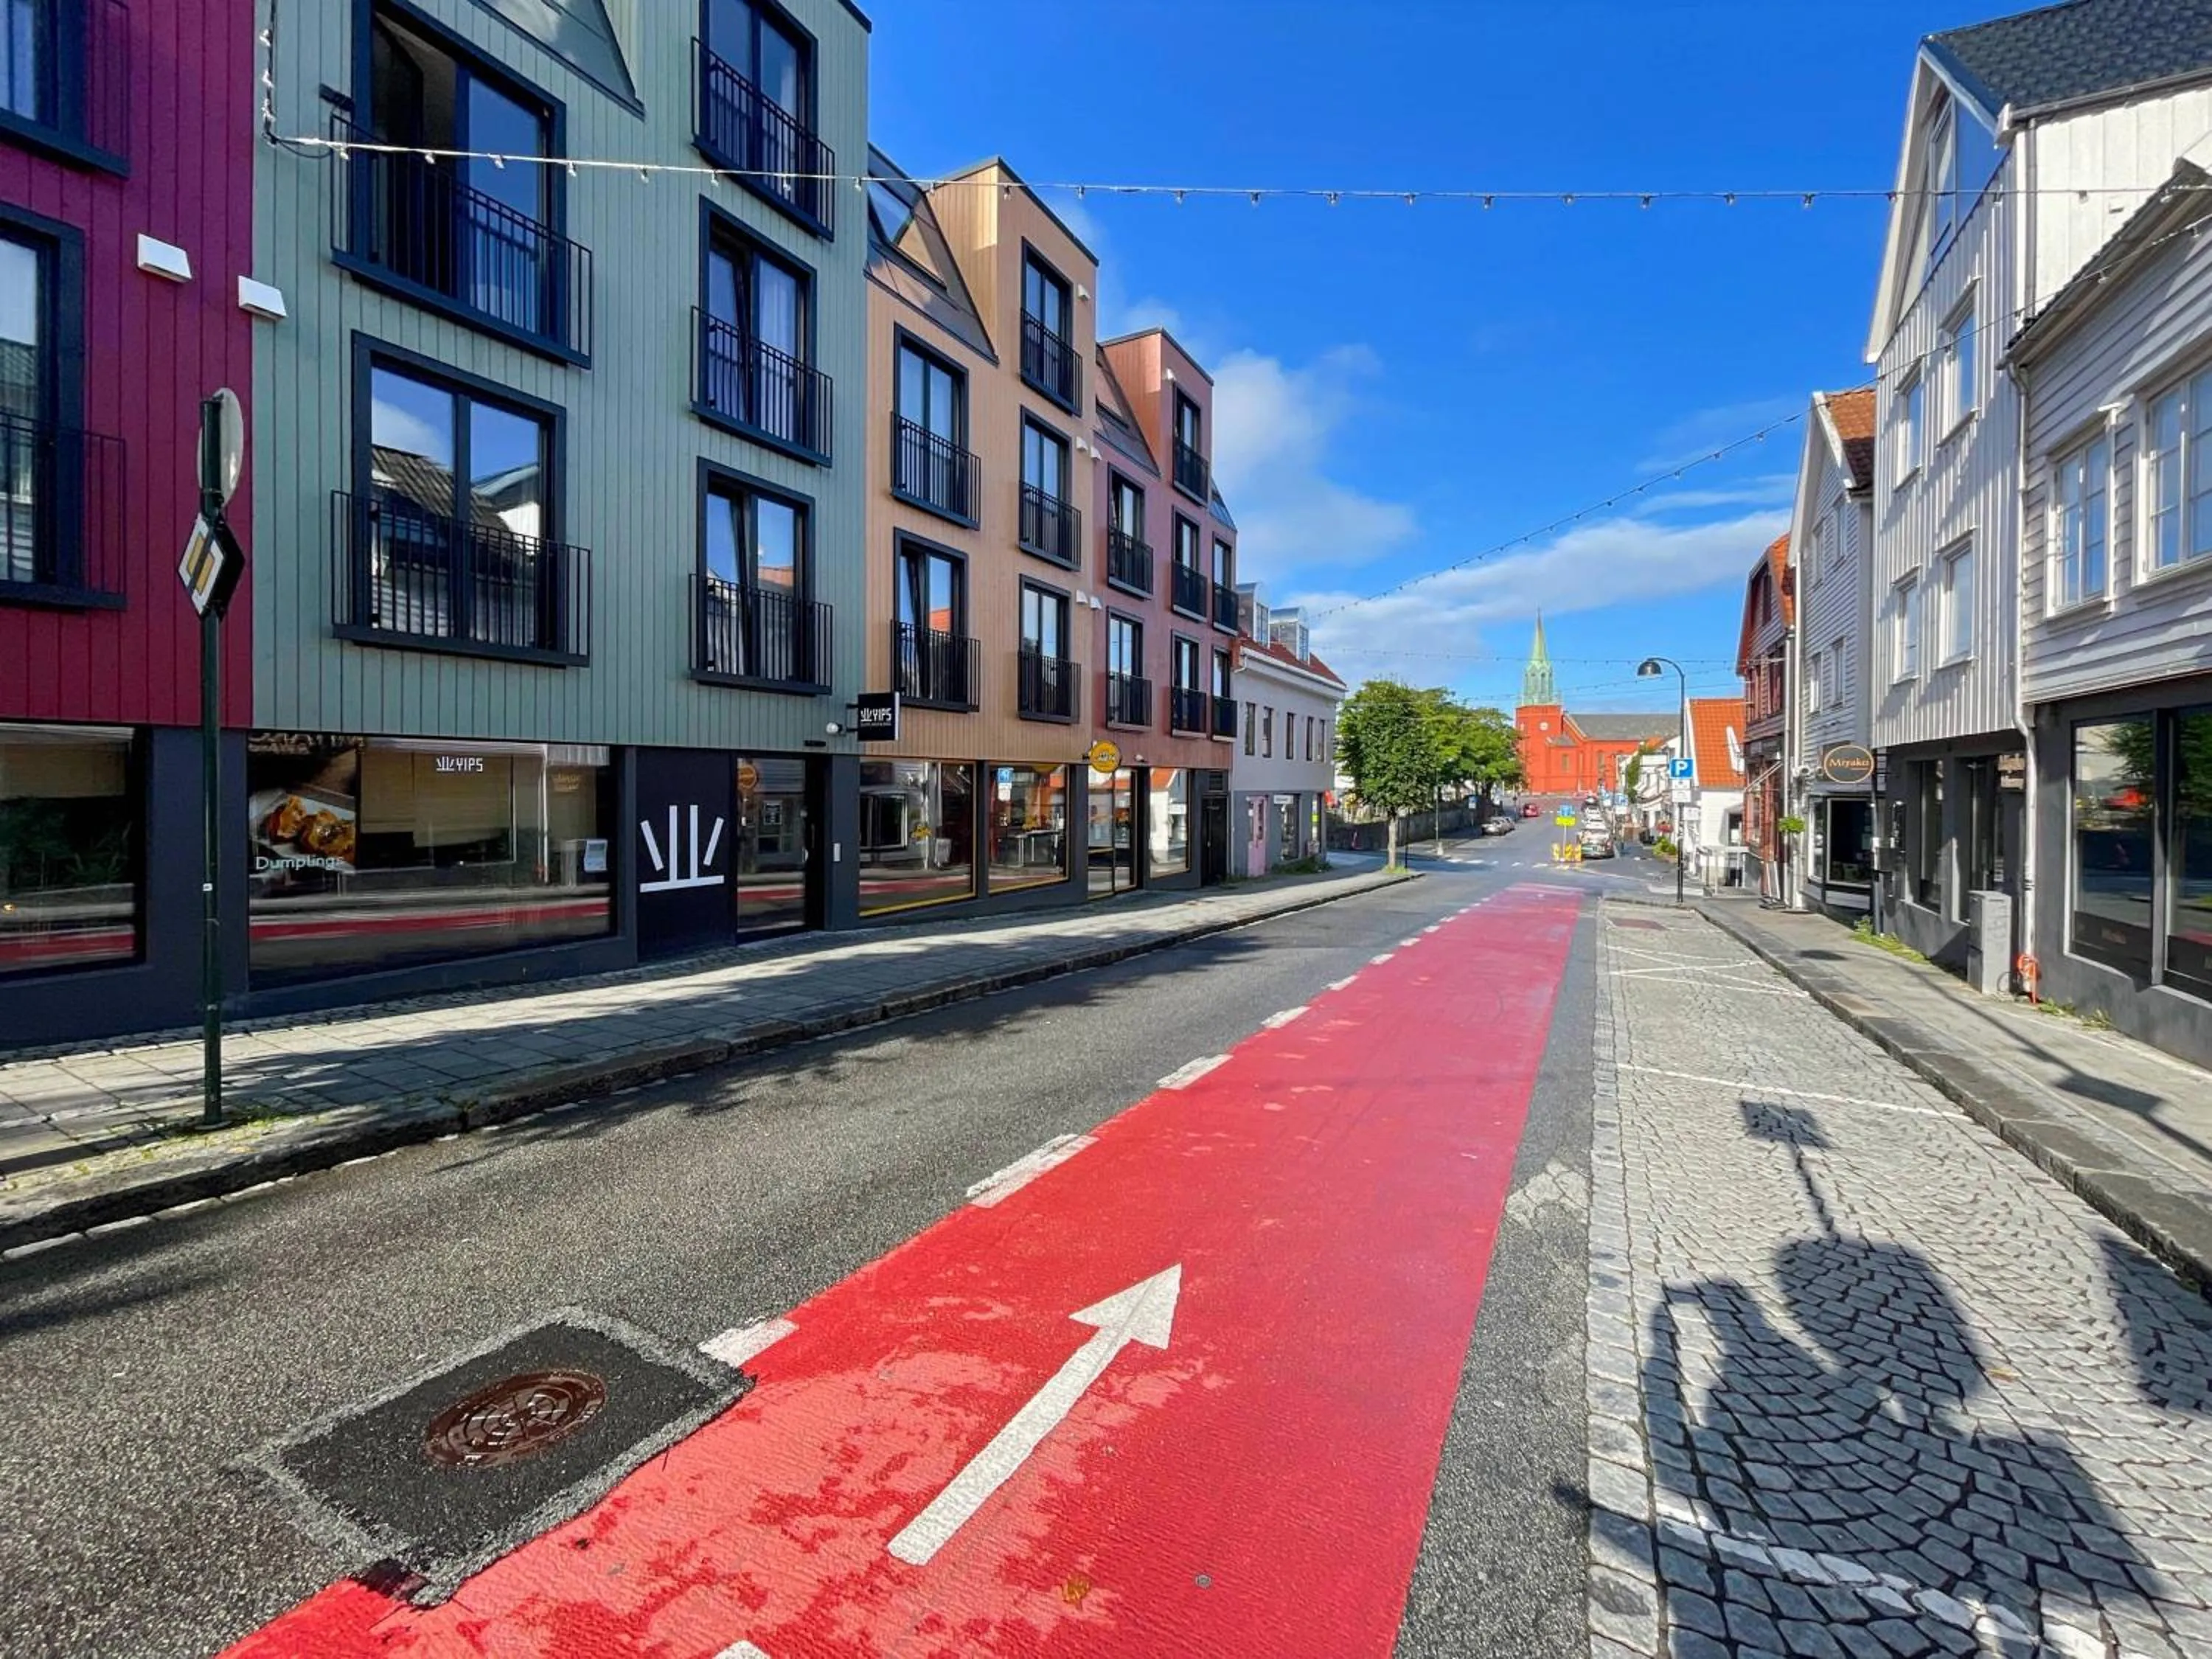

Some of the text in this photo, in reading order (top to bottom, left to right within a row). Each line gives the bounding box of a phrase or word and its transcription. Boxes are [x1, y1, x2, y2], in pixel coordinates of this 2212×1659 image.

[872, 708, 891, 722] YIPS
[456, 757, 483, 772] YIPS
[1675, 760, 1688, 776] P
